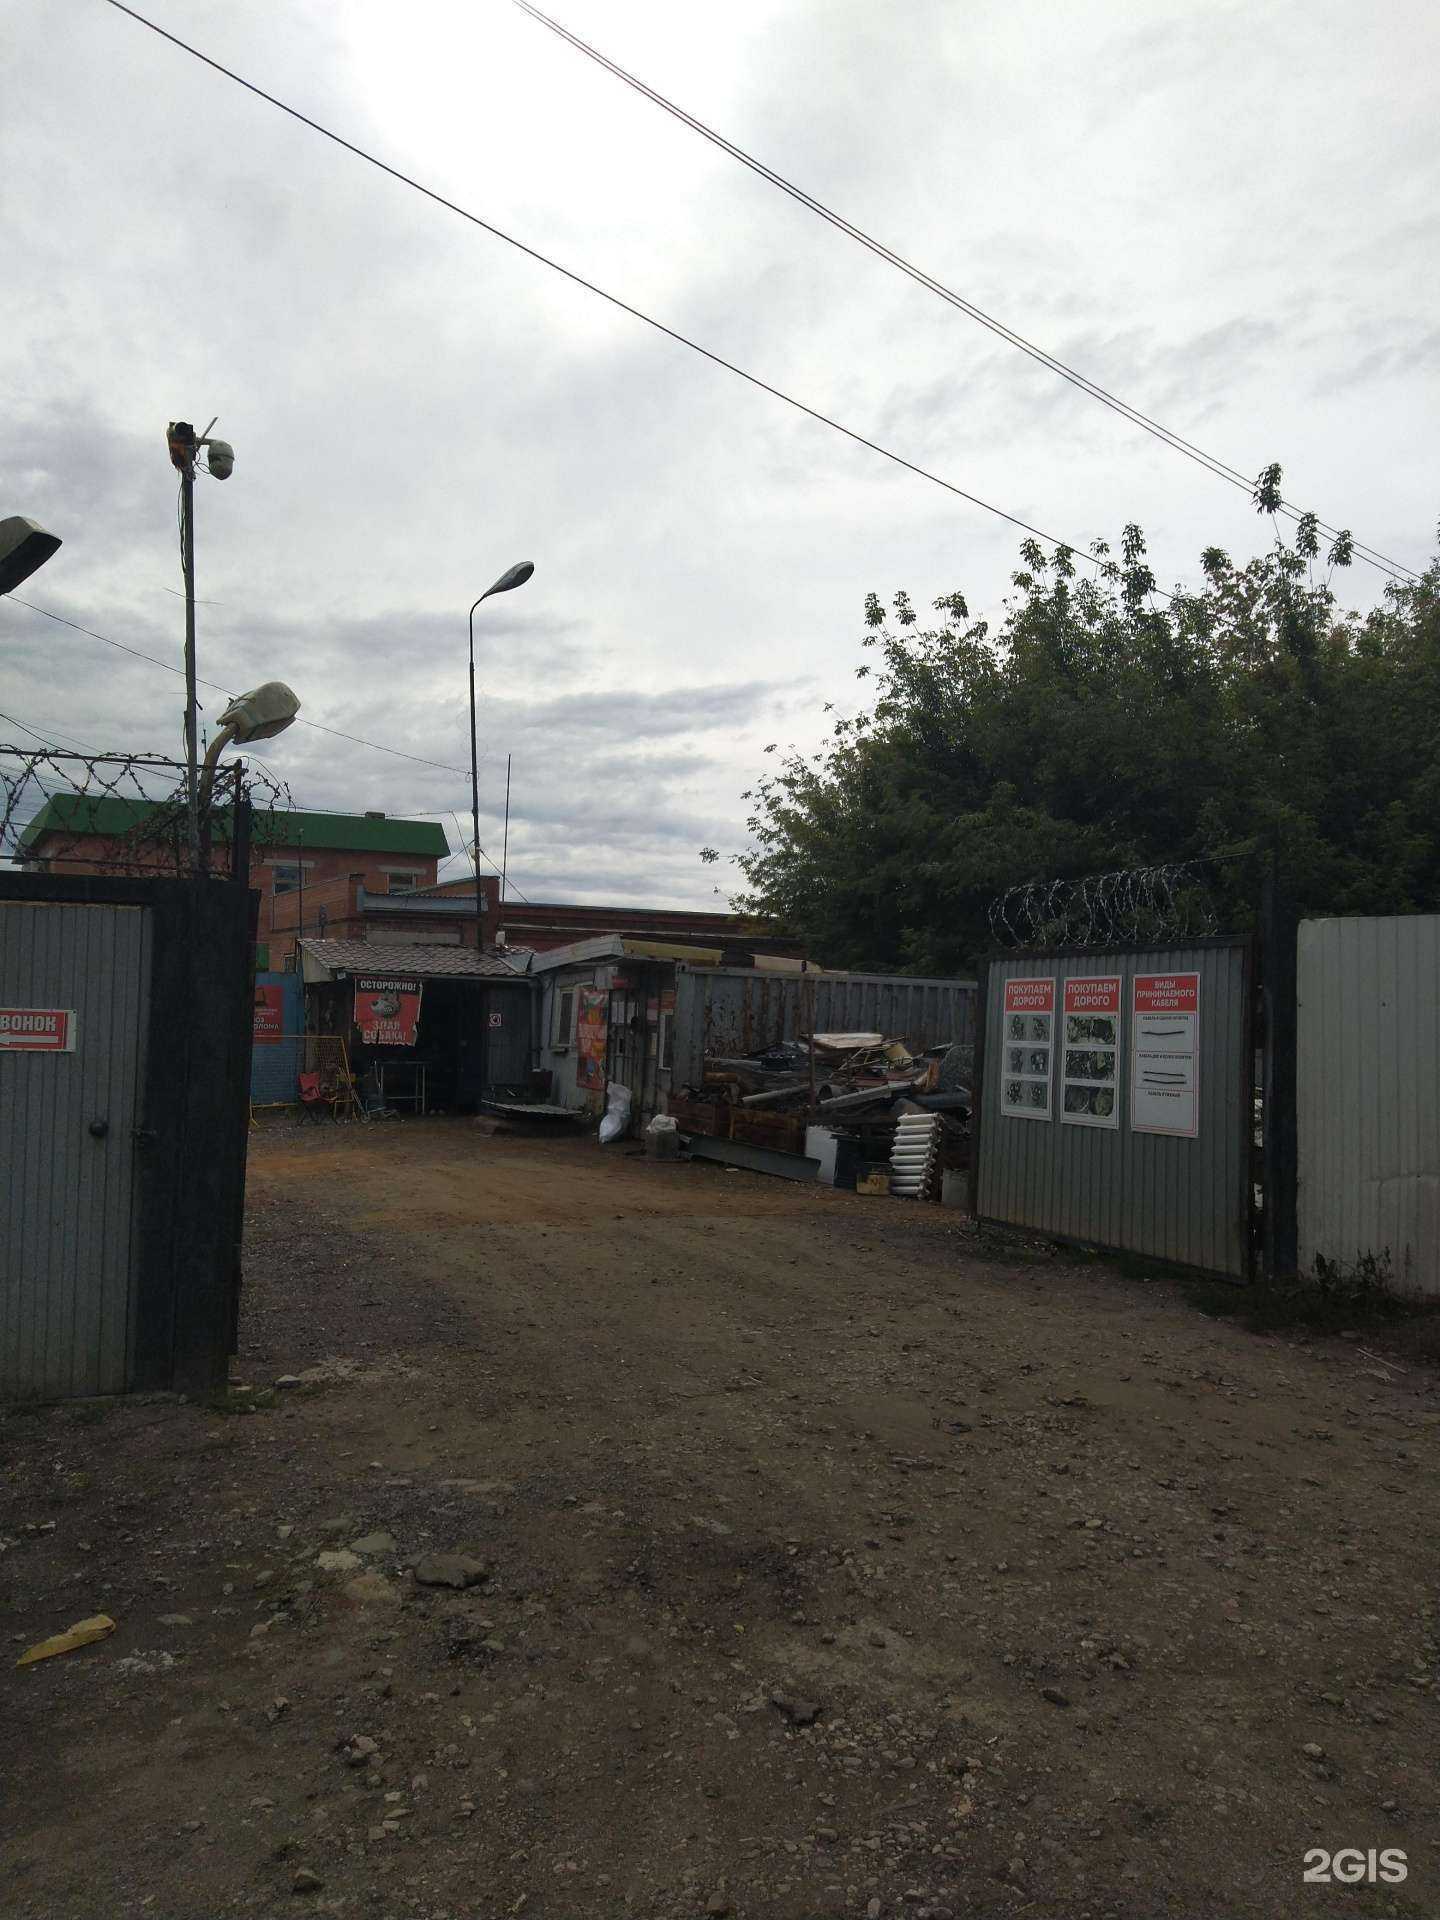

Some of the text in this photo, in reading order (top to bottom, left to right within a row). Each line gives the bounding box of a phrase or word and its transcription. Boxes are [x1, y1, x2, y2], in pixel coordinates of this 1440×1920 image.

[360, 980, 417, 991] ОСТОРОЖНО!
[1008, 984, 1052, 995] ПОКУПАЕМ
[1068, 983, 1117, 994] ПОКУПАЕМ
[1012, 996, 1045, 1007] ДОРОГО
[1073, 996, 1110, 1008] ДОРОГО
[1151, 999, 1179, 1008] КАБЕЛЯ
